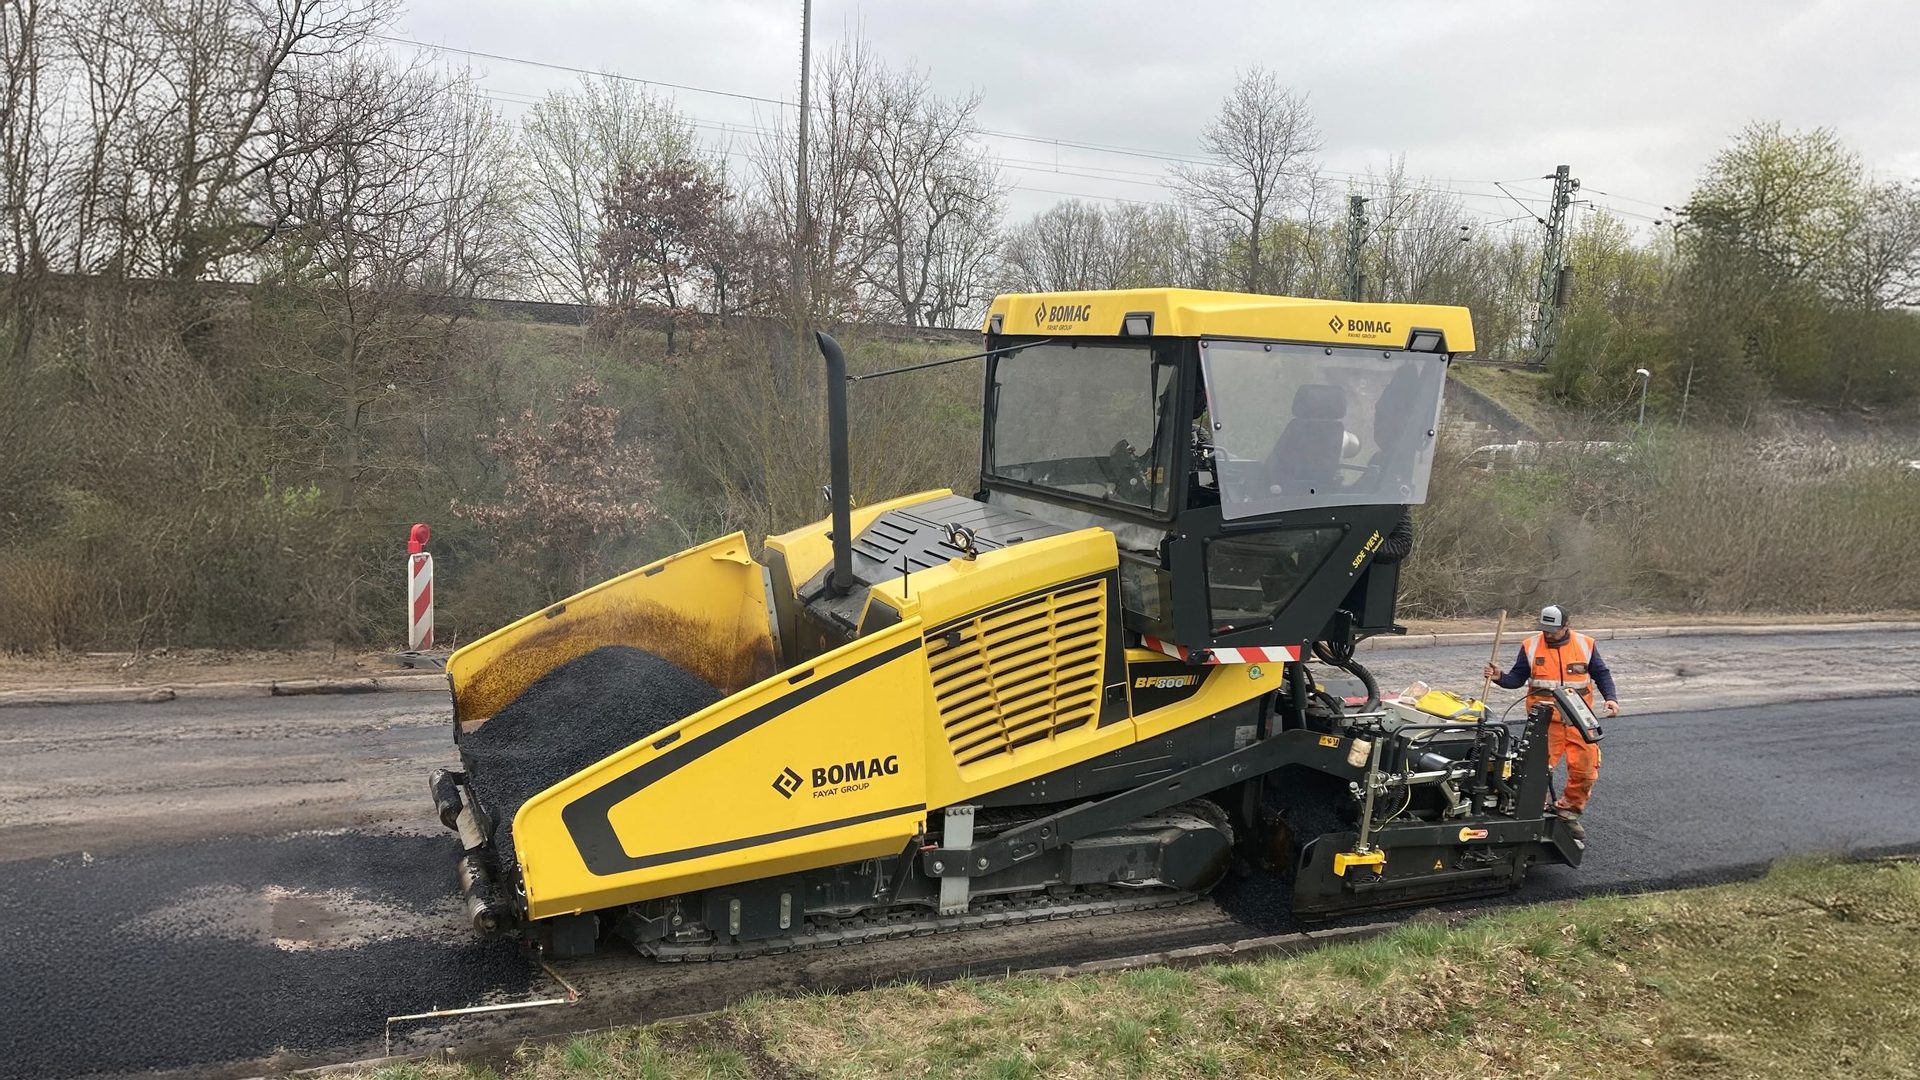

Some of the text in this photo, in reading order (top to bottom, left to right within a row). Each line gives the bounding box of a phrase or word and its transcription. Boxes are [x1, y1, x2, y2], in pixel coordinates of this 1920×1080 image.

[1048, 304, 1091, 322] BOMAG
[1347, 319, 1392, 333] BOMAG
[1352, 549, 1366, 569] SIDE
[1363, 529, 1380, 551] VIEW
[811, 755, 899, 788] BOMAG
[812, 782, 870, 799] FAYAT GROUP
